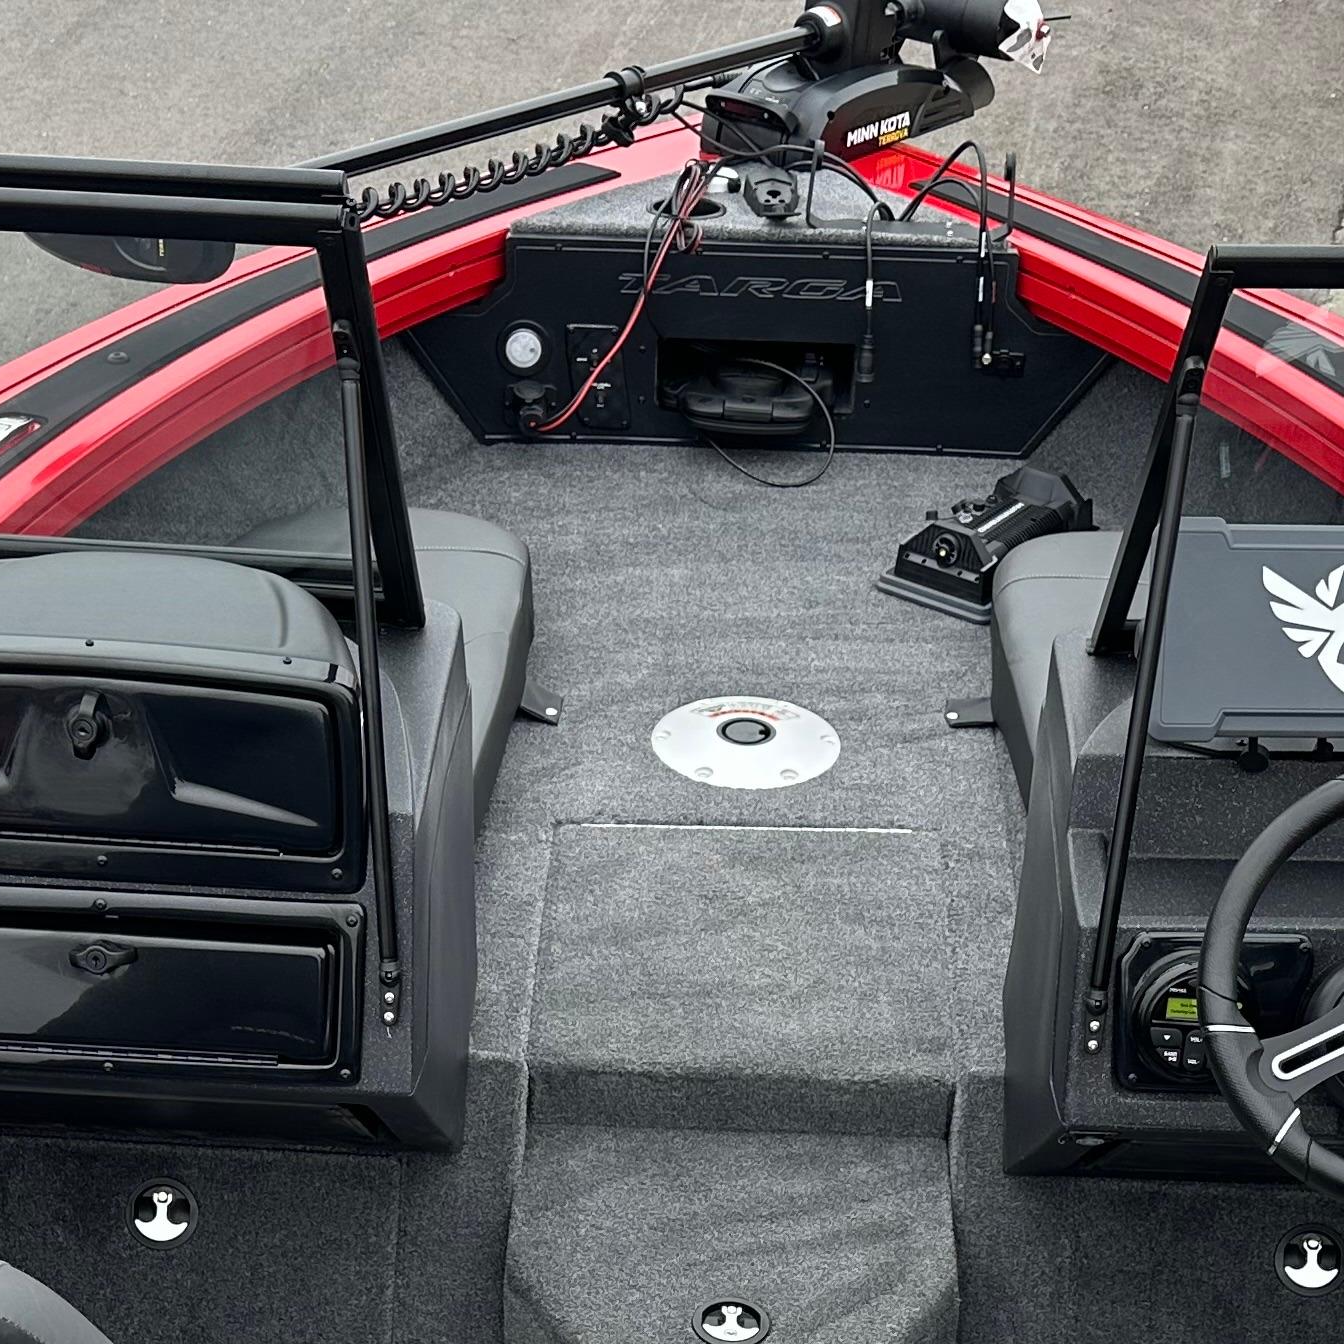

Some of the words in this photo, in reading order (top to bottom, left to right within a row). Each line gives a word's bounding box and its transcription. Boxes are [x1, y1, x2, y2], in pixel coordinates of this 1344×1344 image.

[847, 122, 878, 148] MINN
[879, 111, 911, 135] KOTA
[878, 128, 909, 147] TERROVA
[618, 272, 902, 302] TARGA
